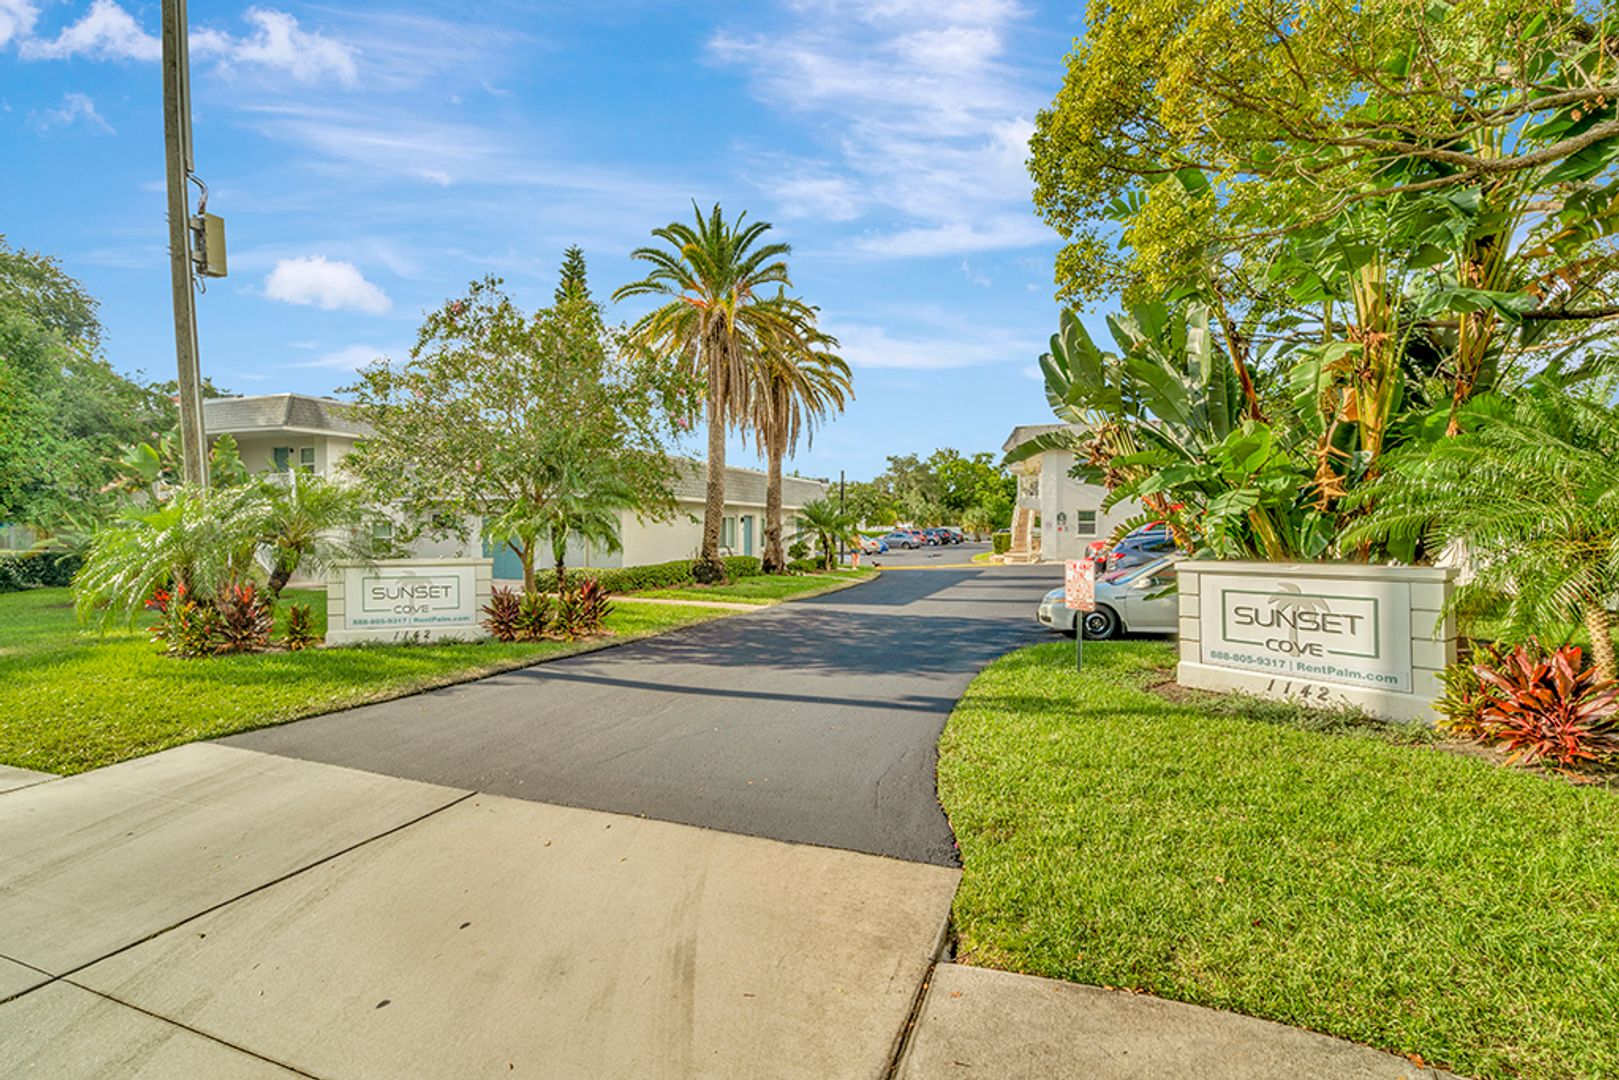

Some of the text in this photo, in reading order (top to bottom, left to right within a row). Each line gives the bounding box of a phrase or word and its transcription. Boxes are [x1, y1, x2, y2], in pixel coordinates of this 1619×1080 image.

[371, 585, 452, 600] SUNSET
[393, 604, 430, 614] COVE
[1233, 605, 1364, 635] SUNSET
[1265, 638, 1324, 657] COVE
[1209, 650, 1286, 669] 888-805-9317
[1296, 661, 1399, 685] RentPalm.com
[1266, 678, 1330, 701] 1142
